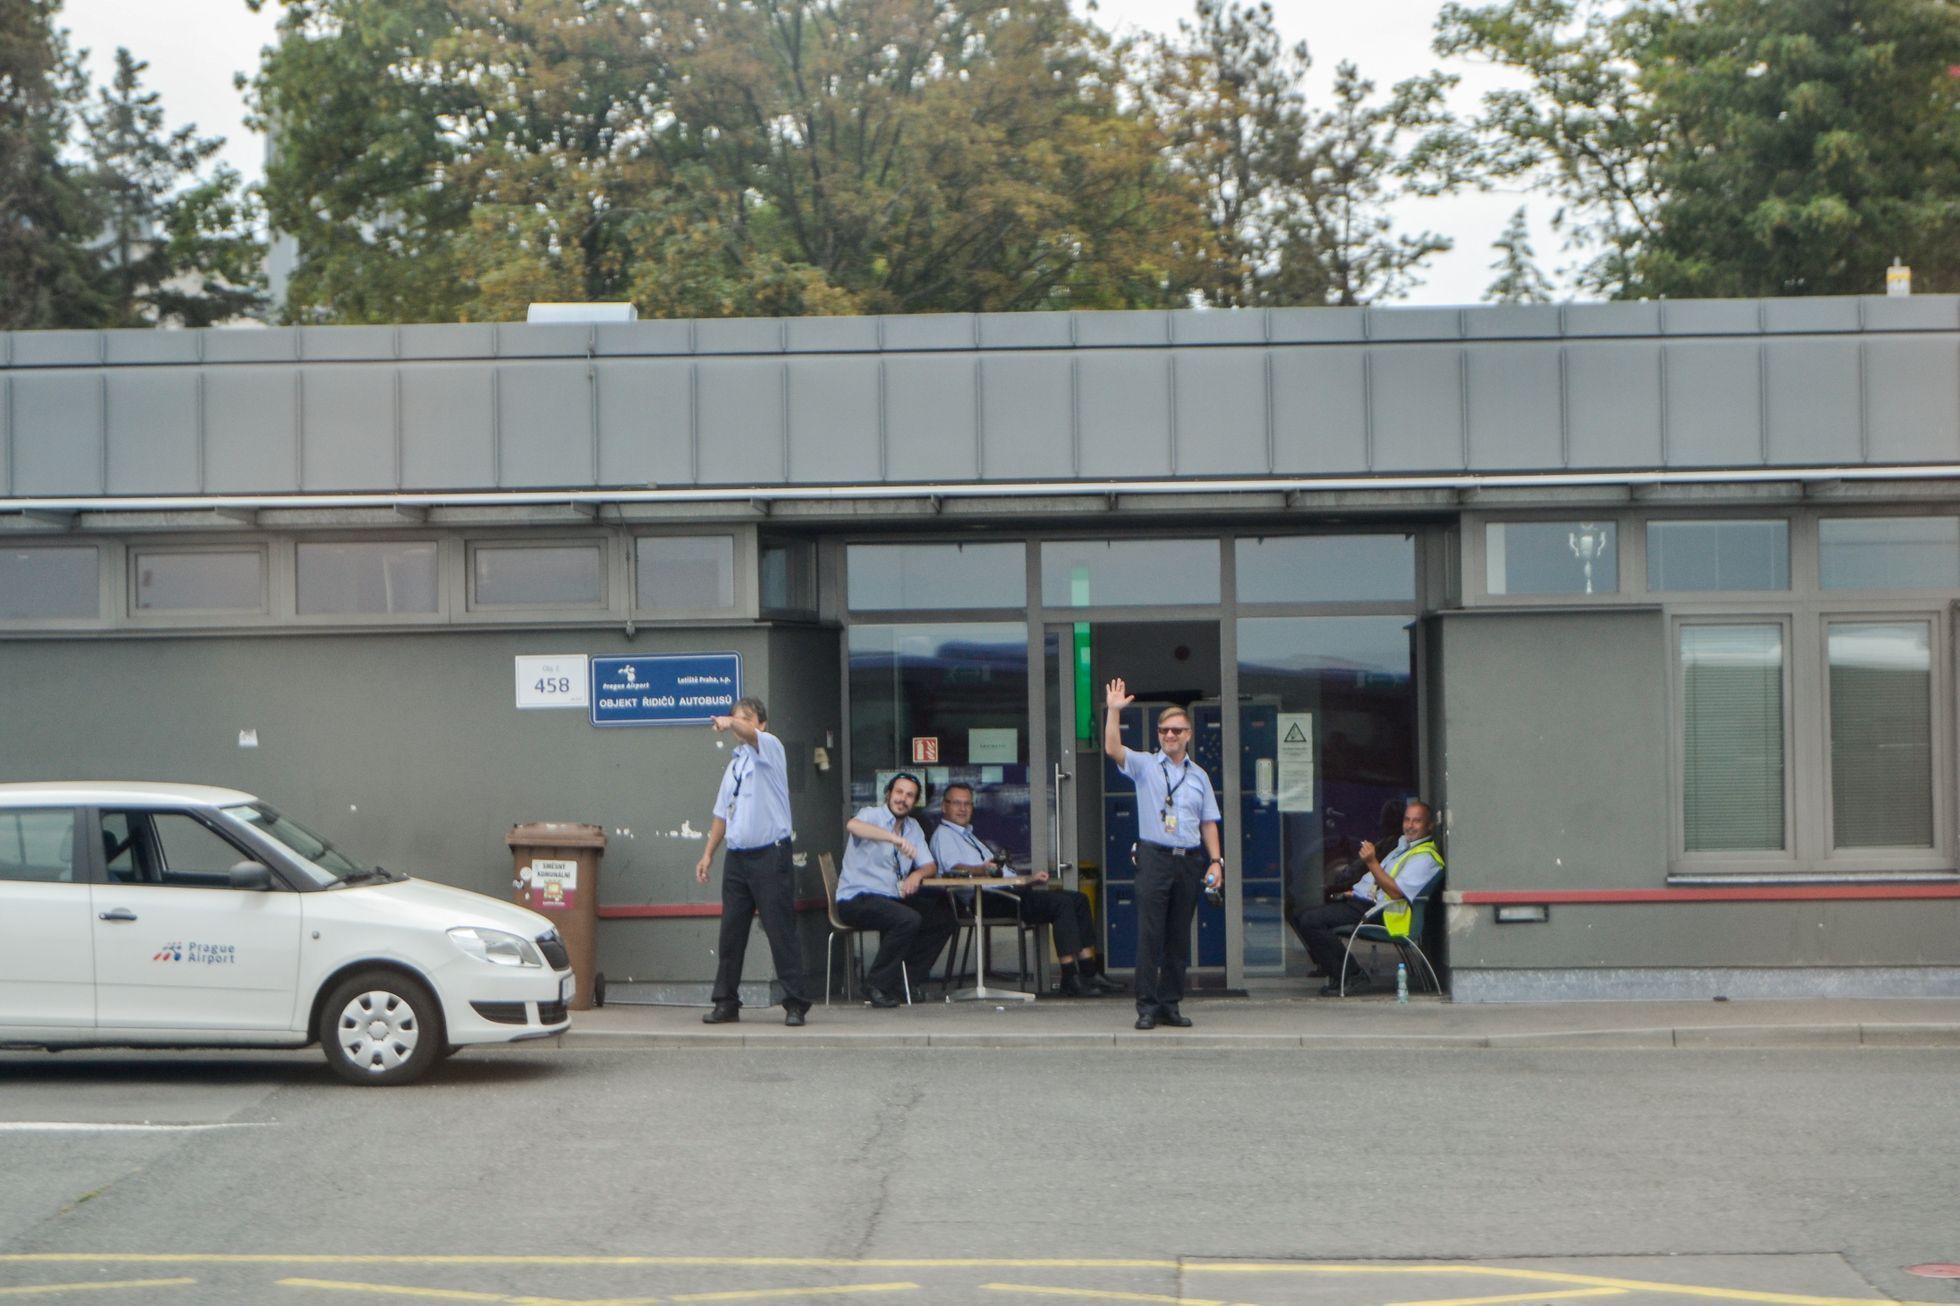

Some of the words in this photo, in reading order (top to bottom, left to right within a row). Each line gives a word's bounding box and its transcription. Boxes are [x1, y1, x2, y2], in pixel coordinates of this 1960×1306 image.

[534, 677, 570, 693] 458
[602, 683, 625, 691] Prague
[626, 682, 649, 690] Airport
[599, 698, 637, 708] OBJEKT
[642, 696, 675, 707] ŘIDIČŮ
[679, 694, 732, 706] AUTOBUSŮ
[188, 942, 235, 955] Prague
[188, 954, 235, 965] Airport
